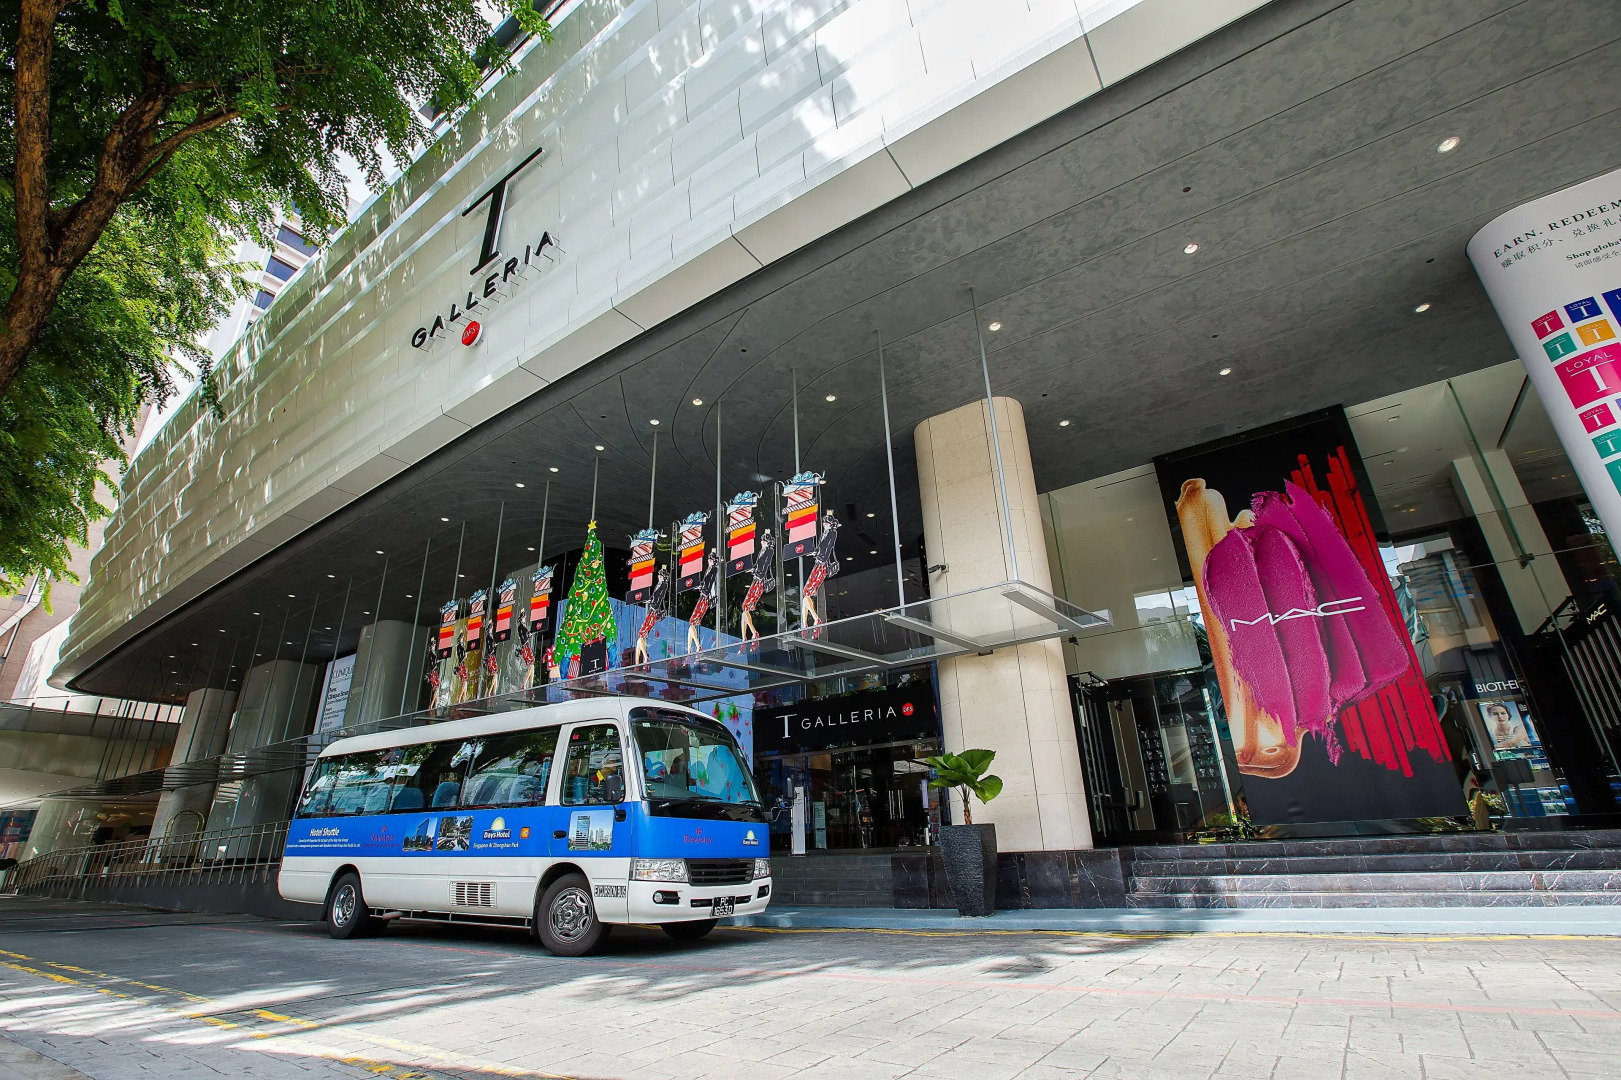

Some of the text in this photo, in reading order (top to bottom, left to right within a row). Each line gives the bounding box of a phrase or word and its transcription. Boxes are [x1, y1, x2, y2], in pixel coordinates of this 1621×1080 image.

[462, 147, 543, 275] T
[1494, 230, 1543, 259] EARN.
[1501, 215, 1621, 269] 赚取积分、兑换礼
[1566, 250, 1592, 261] Shop
[411, 231, 556, 348] GALLERIA
[1569, 300, 1591, 309] LOYAL
[462, 325, 478, 342] DFS
[1566, 351, 1613, 373] LOYAL
[1570, 359, 1615, 393] T
[1583, 407, 1604, 418] LOYAL
[1596, 432, 1618, 443] LOYAL
[775, 713, 798, 739] T
[801, 706, 897, 730] GALLERIA
[309, 827, 340, 837] Hotel Shuttle
[483, 832, 496, 840] Days
[684, 834, 713, 844] RAMADA
[720, 897, 729, 906] PC
